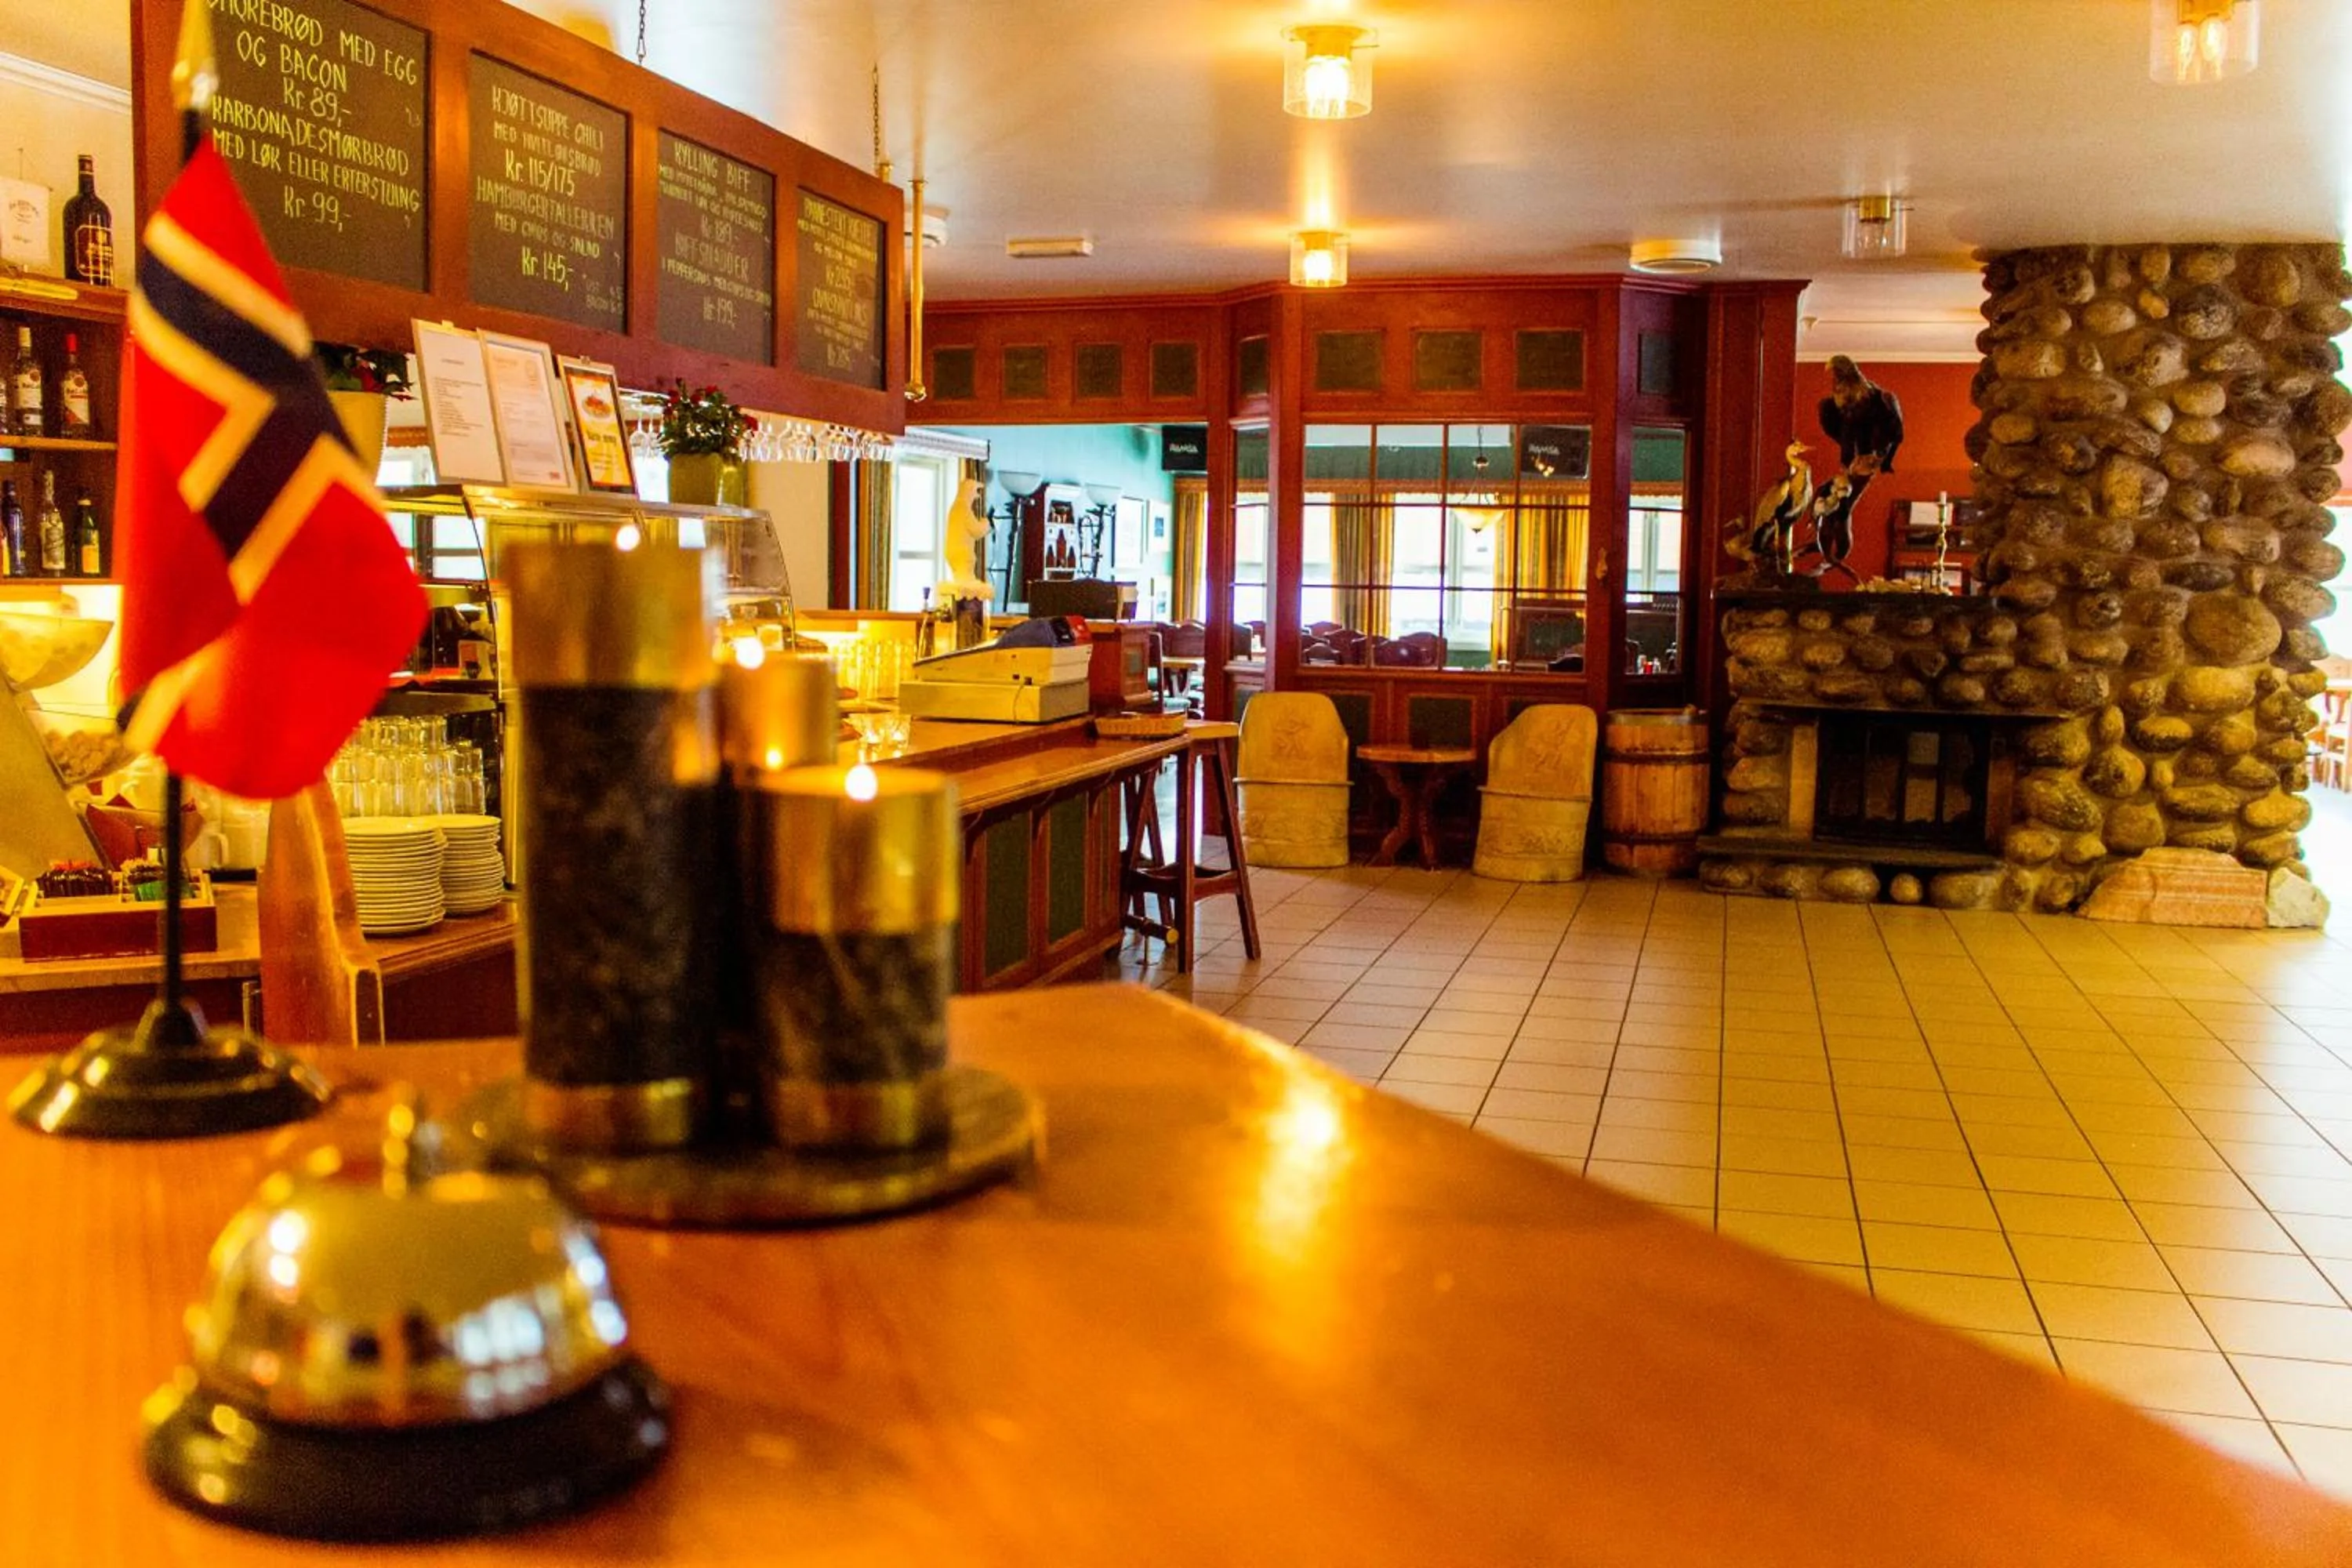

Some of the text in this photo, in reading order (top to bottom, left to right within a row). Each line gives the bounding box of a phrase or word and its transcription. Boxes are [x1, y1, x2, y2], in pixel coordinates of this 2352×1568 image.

[237, 30, 347, 93] OG BACON
[339, 30, 376, 67] MED
[384, 49, 417, 85] EGG
[282, 76, 306, 111] Kr.
[491, 84, 604, 153] KJØTTSUPPE CHILI
[212, 93, 409, 177] KARBONADESMØRBRØD
[212, 126, 245, 159] MED
[251, 138, 282, 173] LØK
[289, 151, 329, 188] ELLER
[493, 120, 517, 143] MED
[504, 147, 578, 198] Kr. 115/175
[674, 140, 718, 179] KYLLING
[726, 162, 752, 193] BIFF
[494, 210, 517, 234] MED
[521, 245, 539, 277] Kr.
